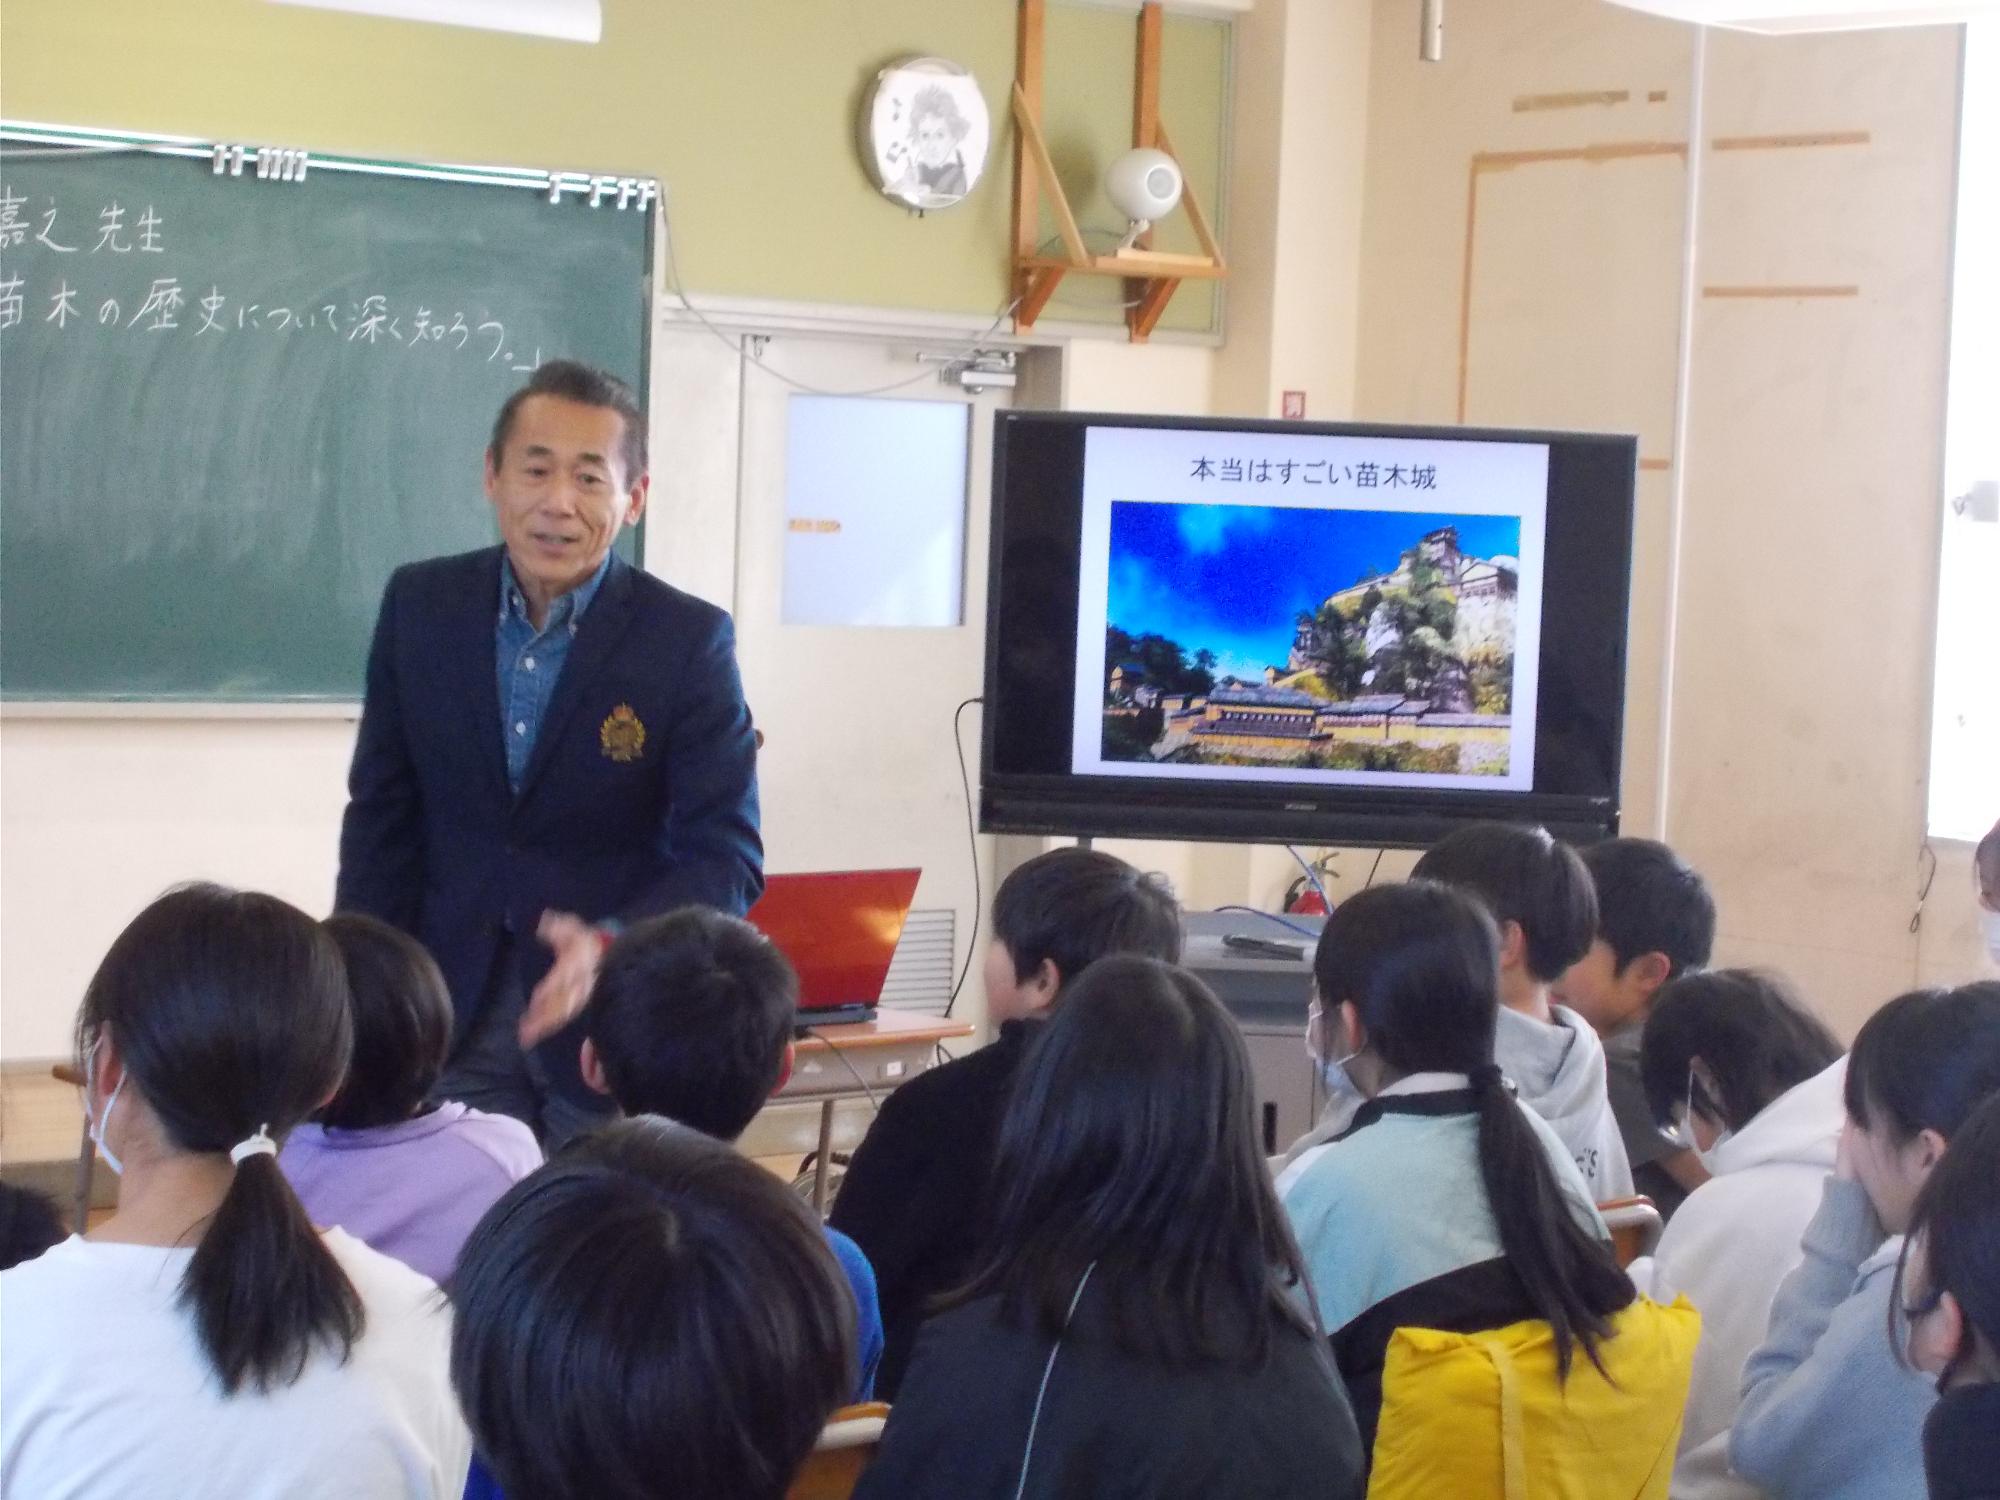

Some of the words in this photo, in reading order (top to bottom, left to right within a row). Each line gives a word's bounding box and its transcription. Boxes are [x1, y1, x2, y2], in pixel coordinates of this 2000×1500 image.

[1190, 455, 1437, 490] 本当はすごい苗木城
